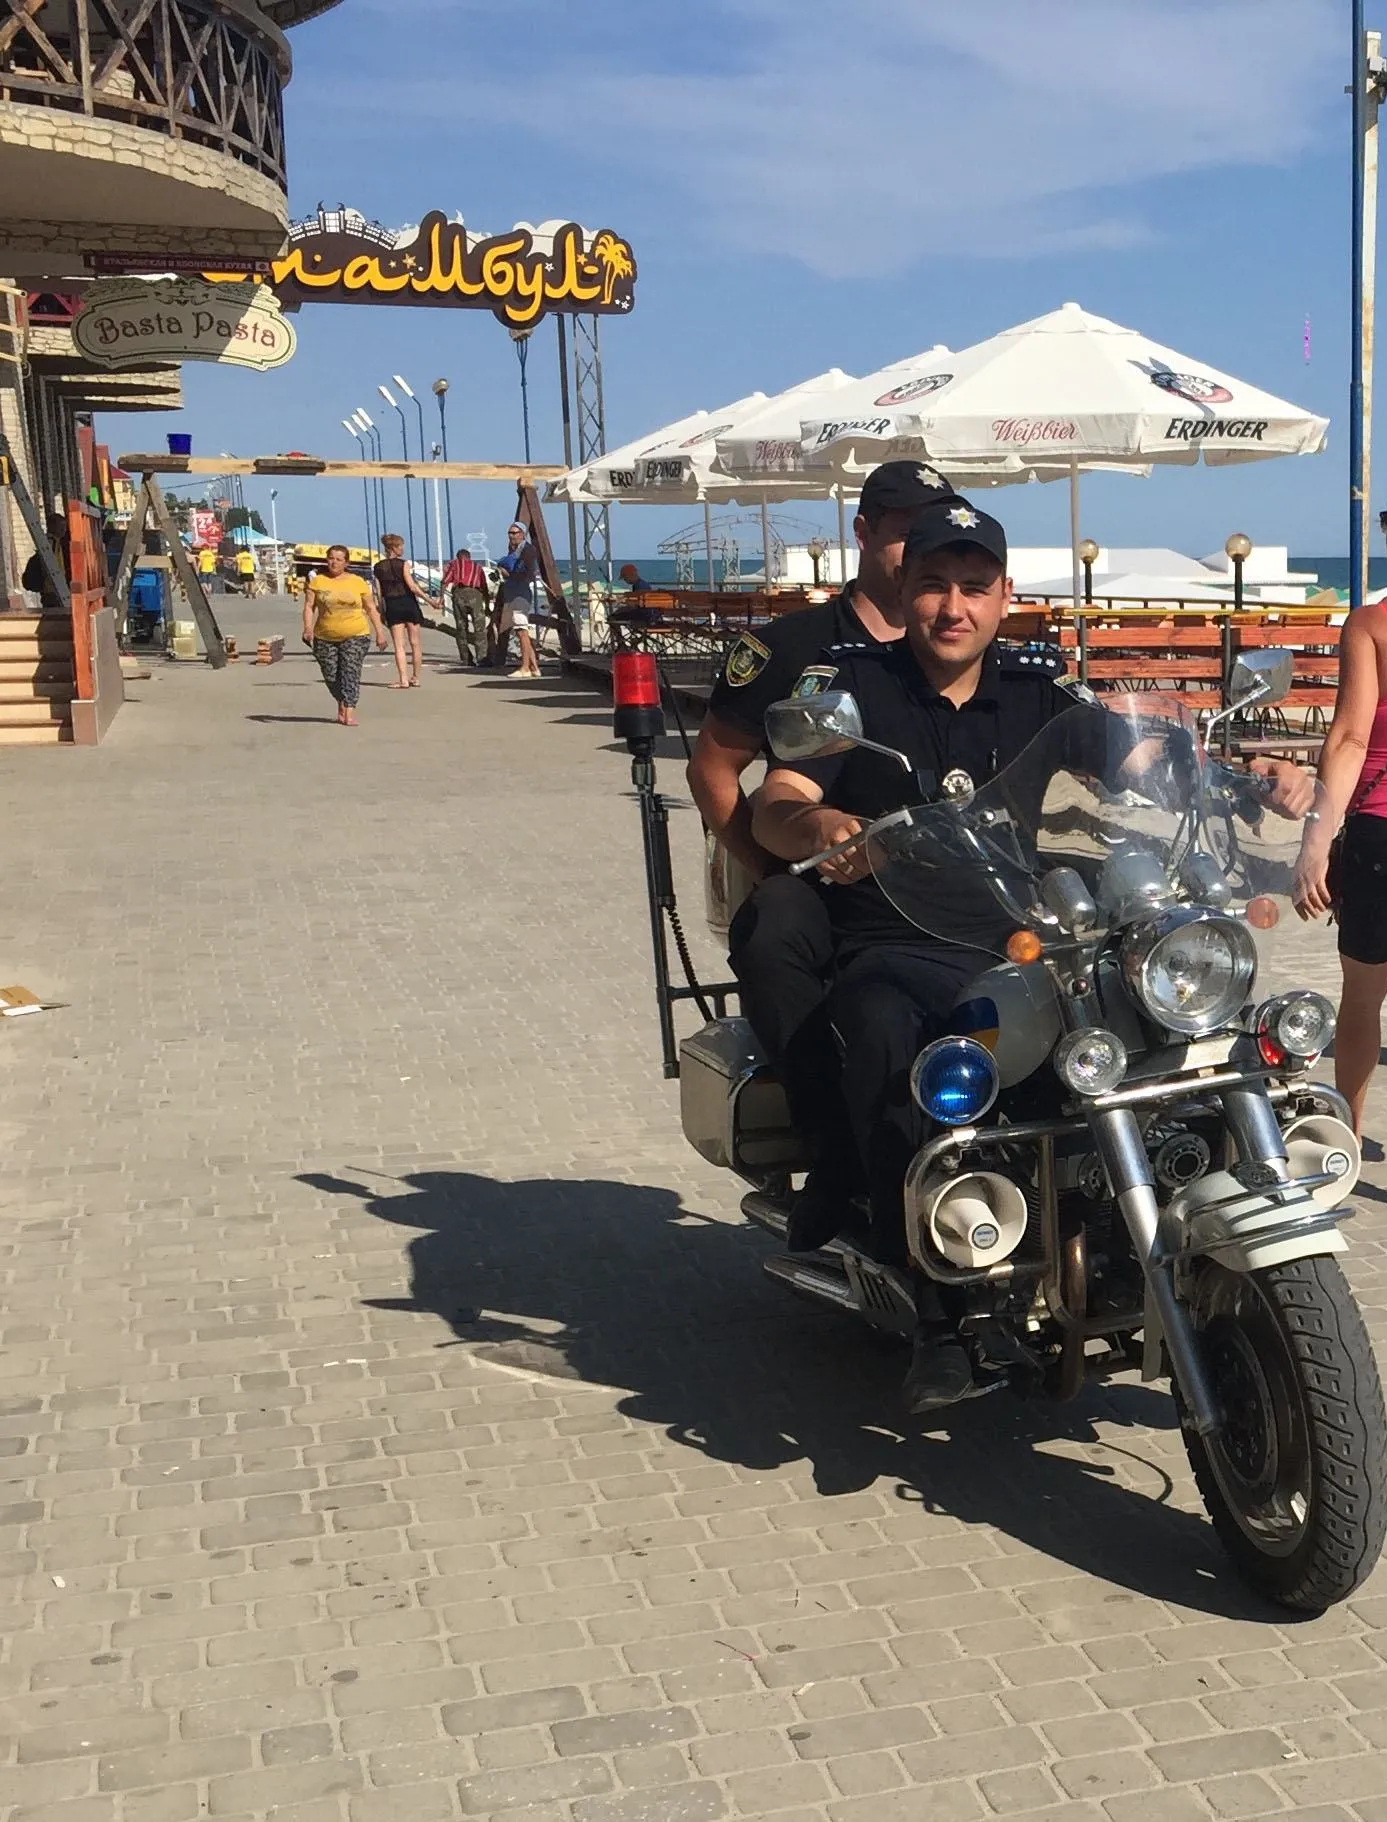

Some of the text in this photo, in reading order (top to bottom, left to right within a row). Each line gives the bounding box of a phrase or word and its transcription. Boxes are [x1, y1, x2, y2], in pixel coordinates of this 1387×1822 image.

[94, 310, 276, 348] Basta Pasta
[992, 418, 1078, 446] Weißbier
[1164, 418, 1268, 441] ERDINGER
